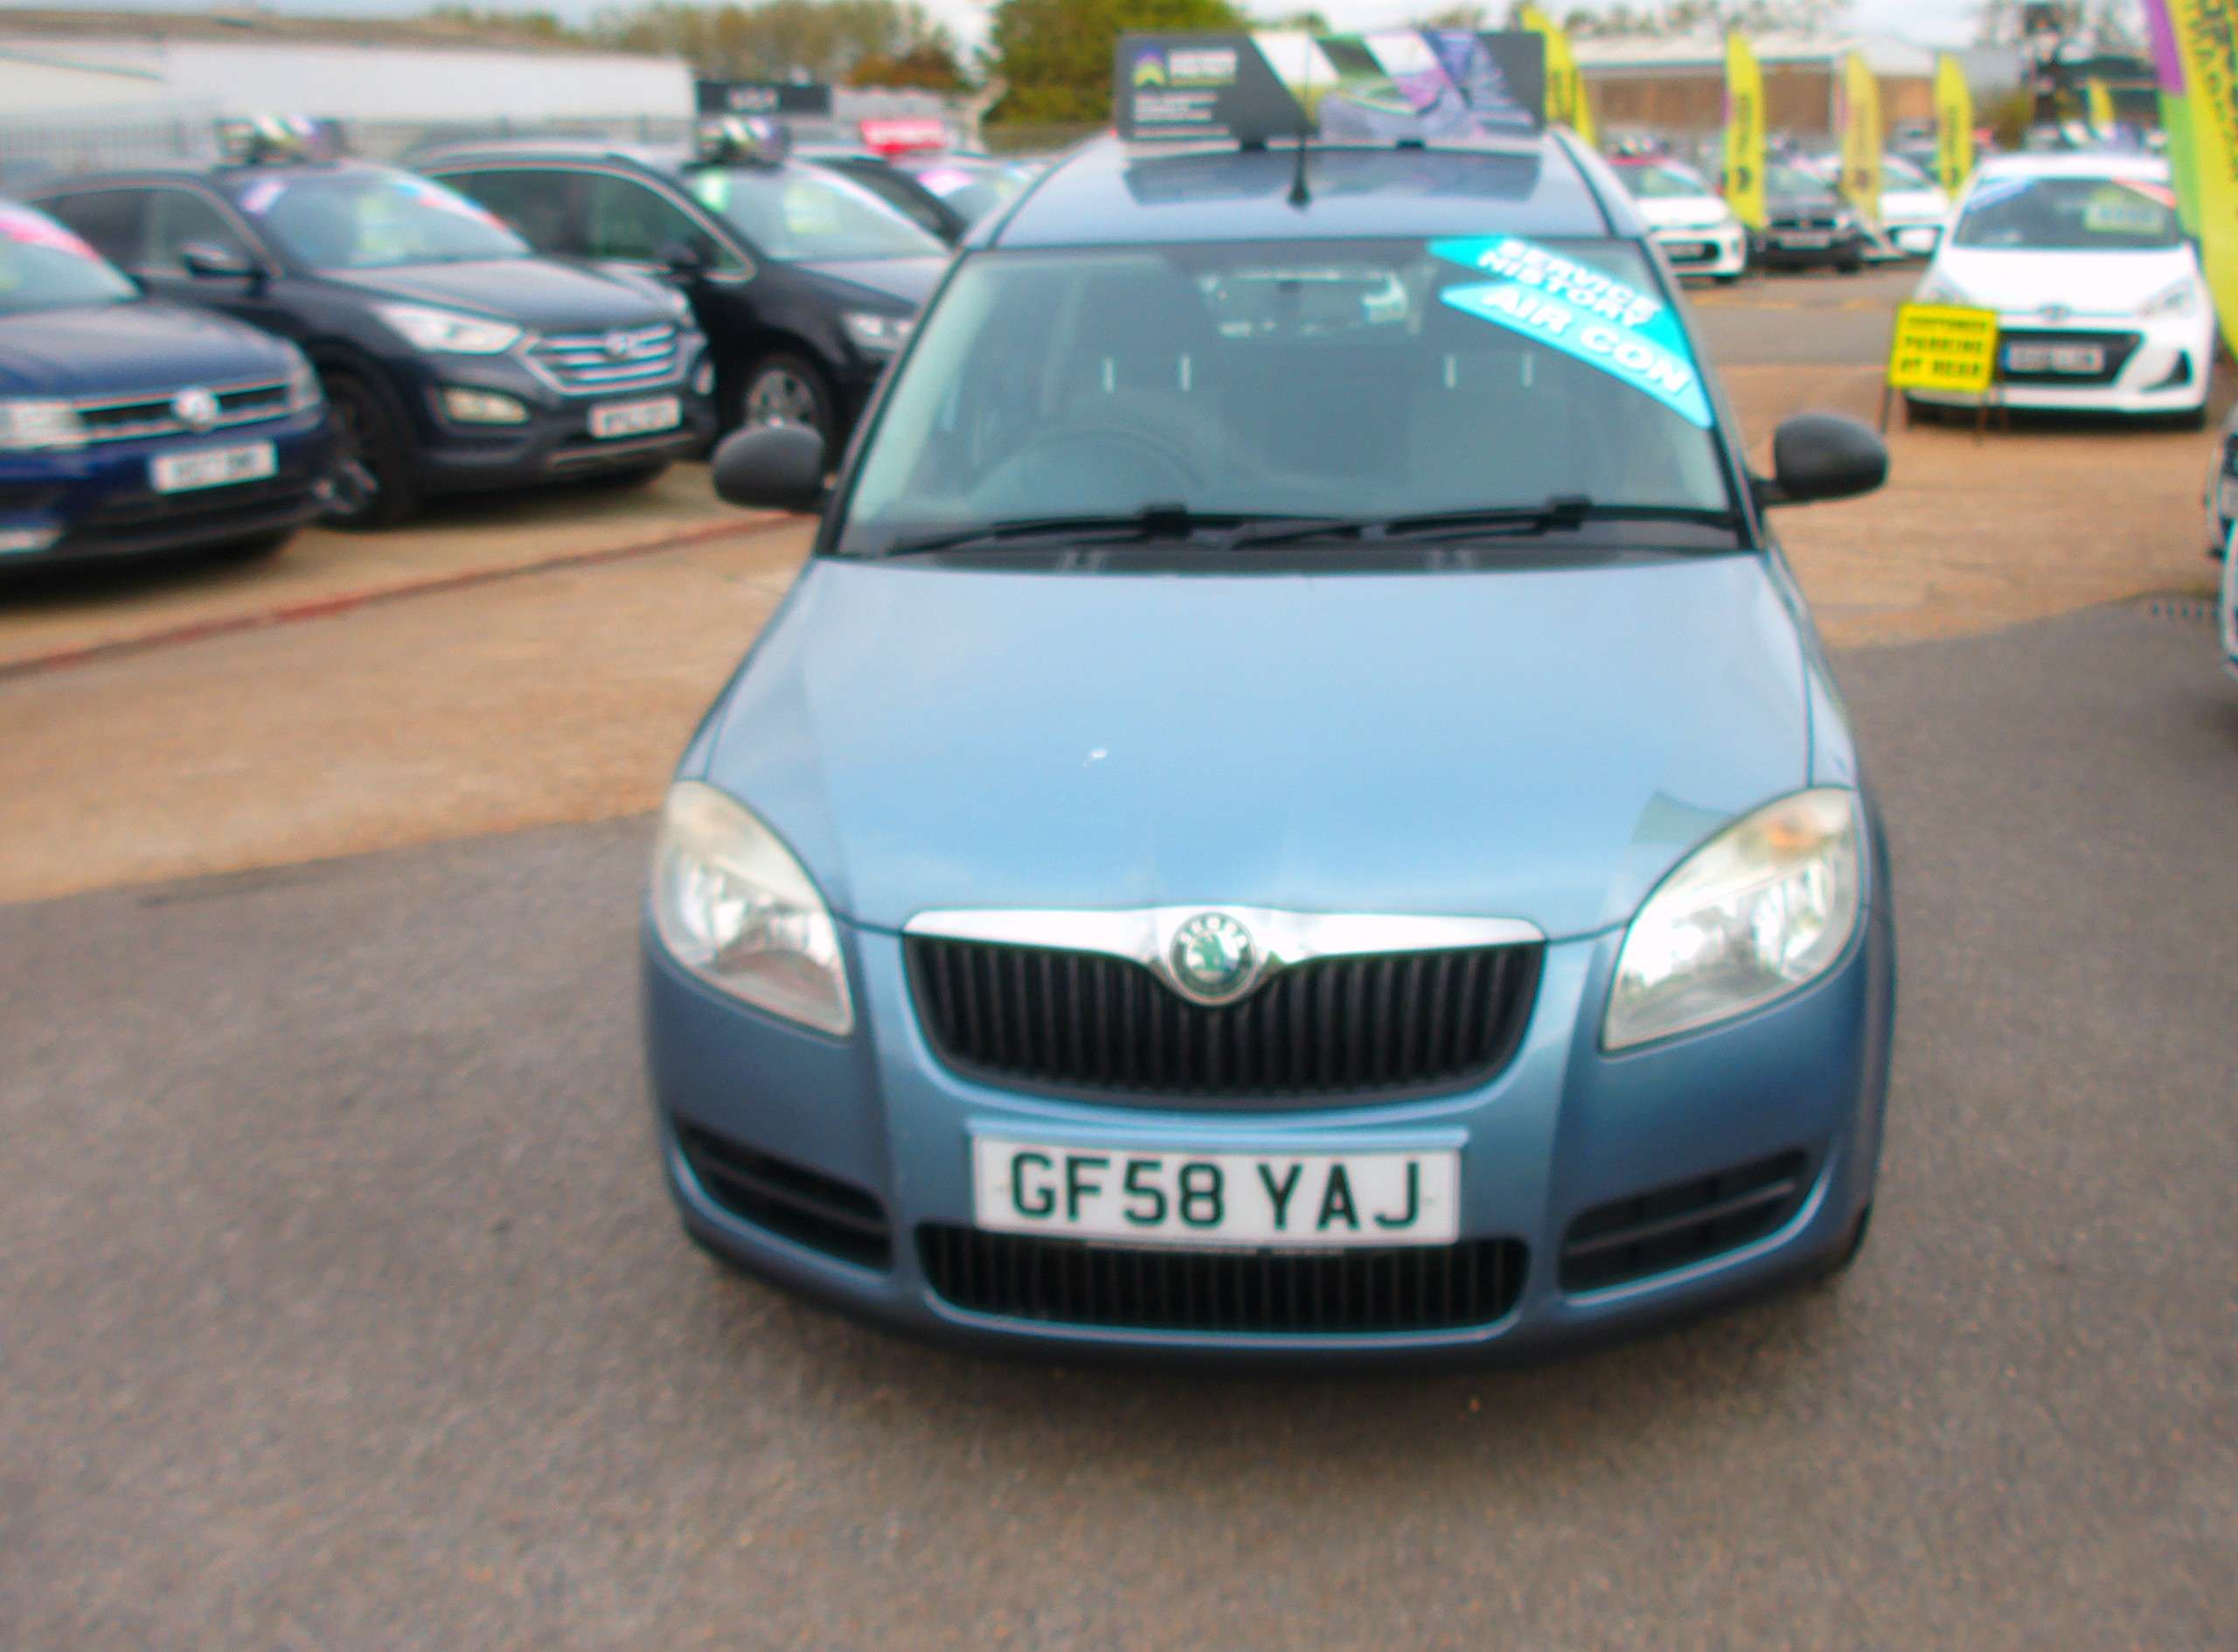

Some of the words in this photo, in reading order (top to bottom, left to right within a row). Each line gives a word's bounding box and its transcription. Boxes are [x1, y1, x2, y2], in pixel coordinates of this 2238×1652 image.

[1477, 251, 1652, 327] HISTORY
[1498, 239, 1661, 316] SERVICE
[1483, 287, 1573, 334] AIR
[1580, 327, 1691, 393] CON
[1011, 1152, 1226, 1230] GF58
[1257, 1161, 1421, 1231] YAJ
